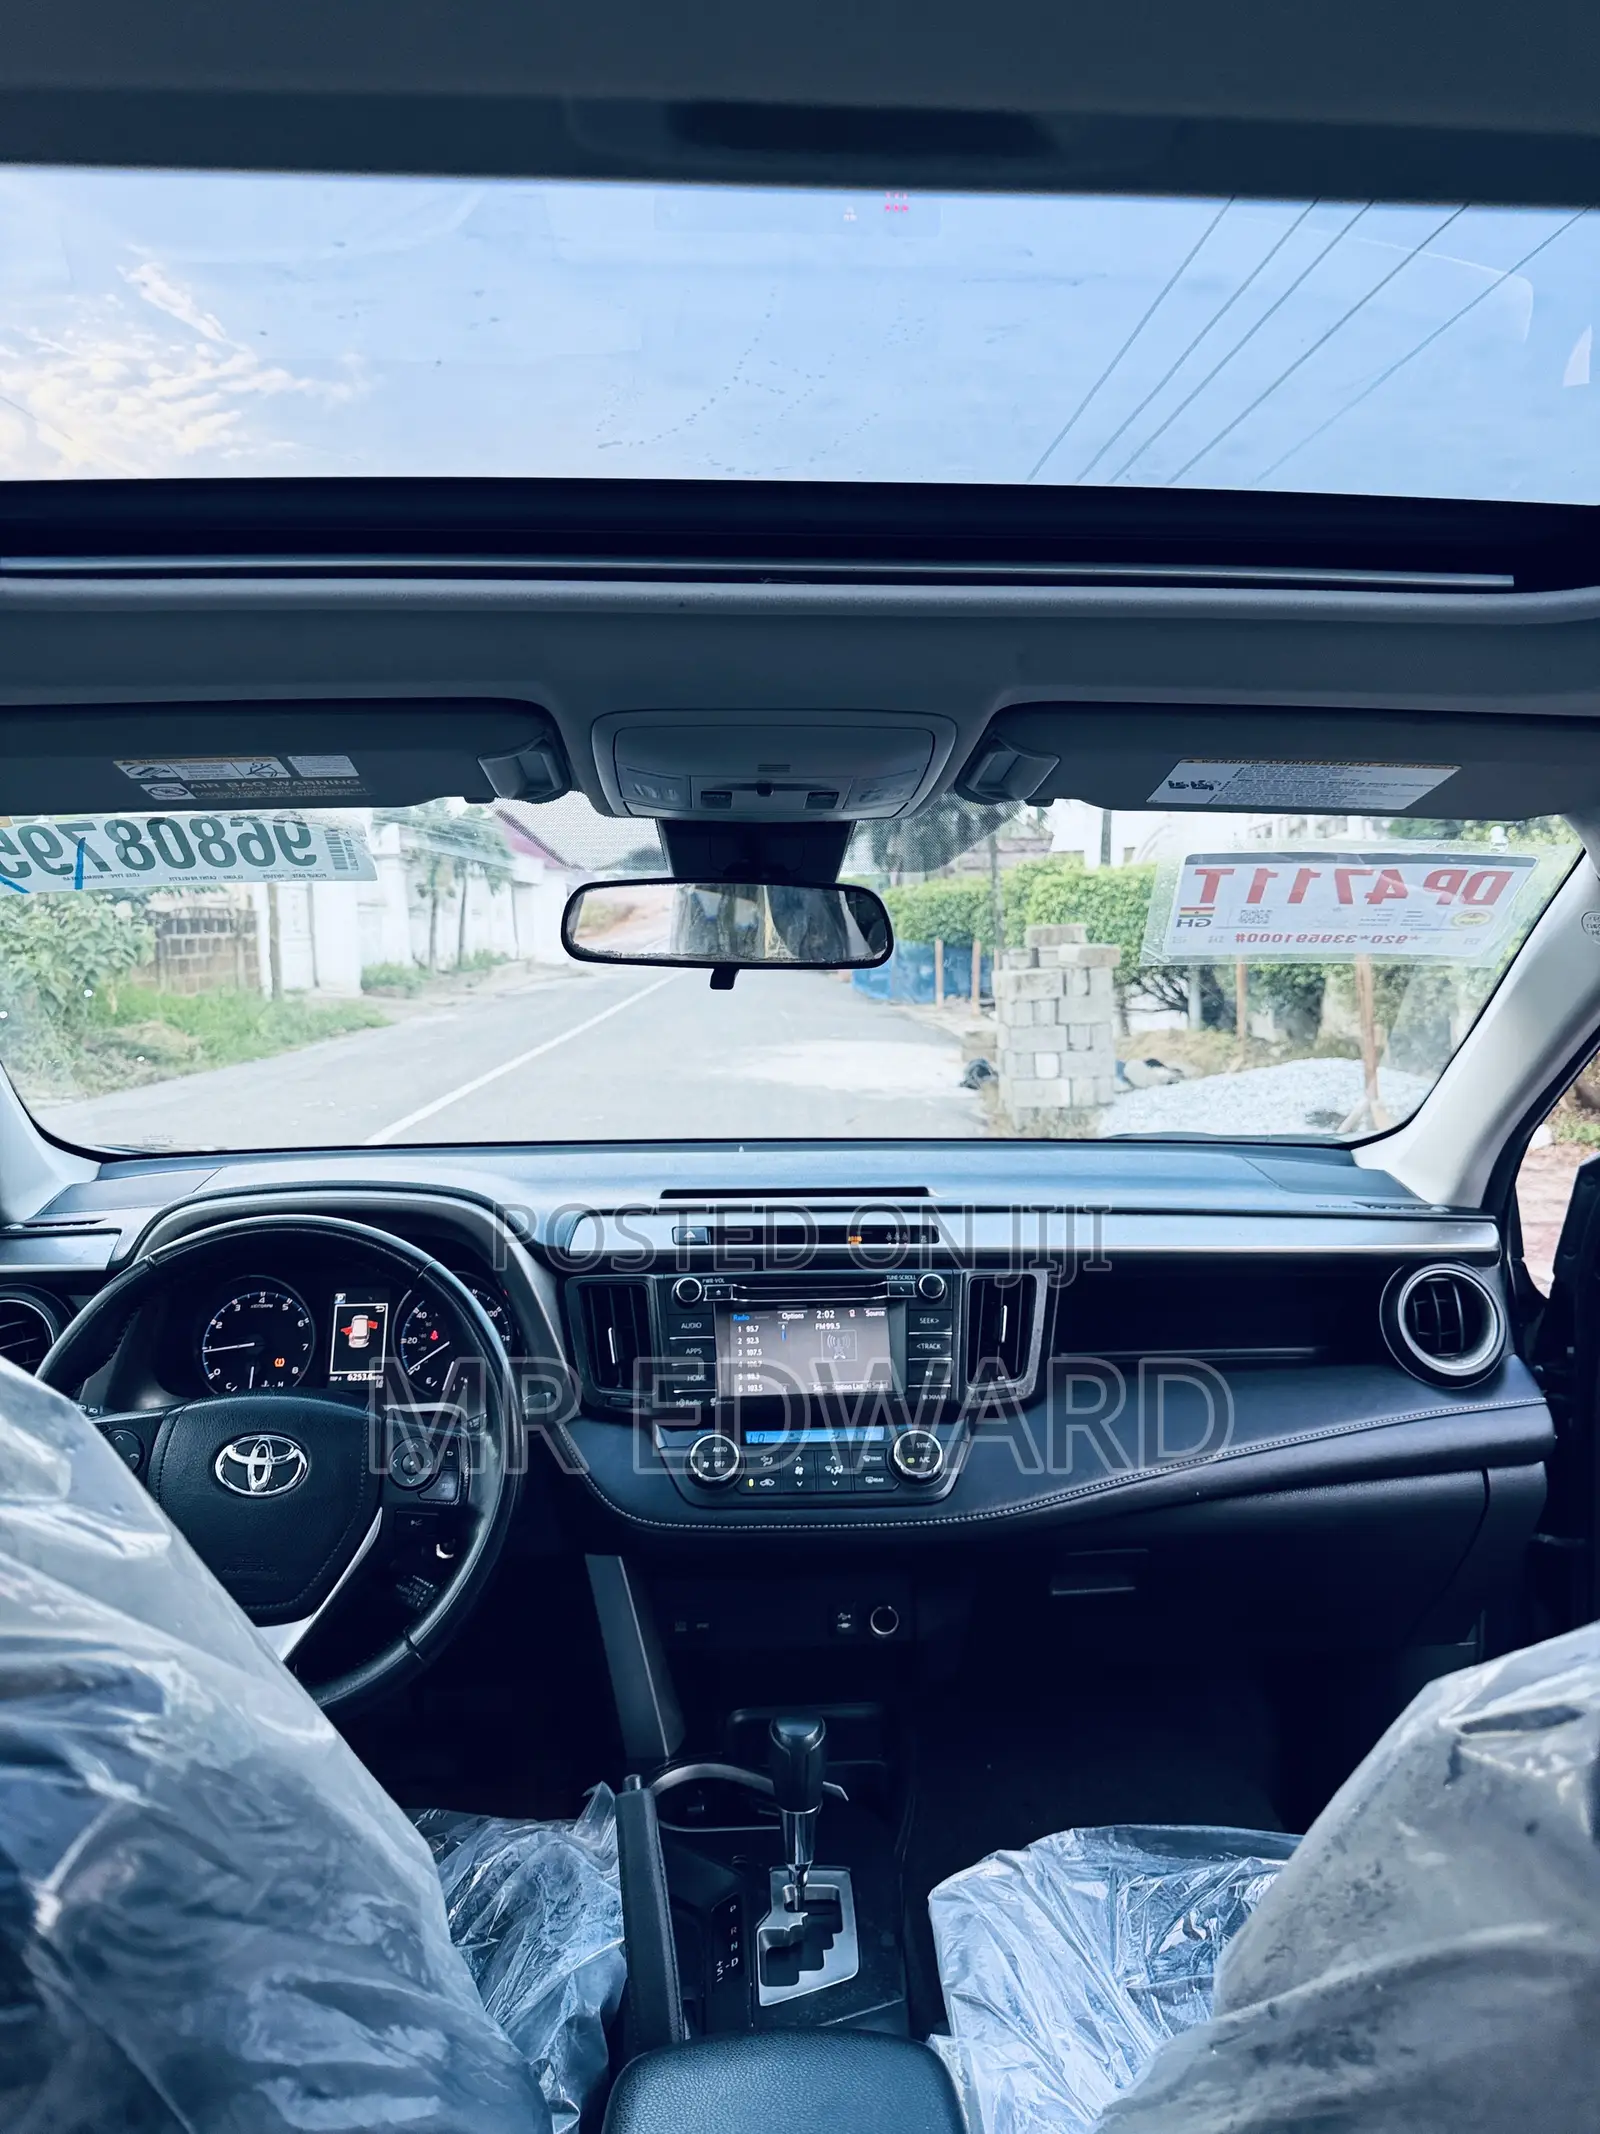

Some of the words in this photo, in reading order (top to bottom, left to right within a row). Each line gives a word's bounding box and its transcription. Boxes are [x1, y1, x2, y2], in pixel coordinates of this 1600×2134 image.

[190, 782, 219, 790] AIR
[225, 780, 266, 788] BAG
[274, 778, 360, 786] WARNING
[234, 1304, 240, 1312] 3
[782, 1312, 804, 1320] Options
[816, 1310, 835, 1318] 2:02
[865, 1309, 885, 1317] Source
[732, 1314, 750, 1322] Radio
[681, 1322, 702, 1330] AUDIO
[214, 1368, 220, 1376] 0
[292, 1366, 298, 1374] 8
[686, 1374, 706, 1382] HOME
[714, 1460, 725, 1468] OFF
[730, 1904, 736, 1912] P
[730, 1926, 737, 1935] R
[730, 1941, 738, 1952] N
[731, 1957, 738, 1968] D
